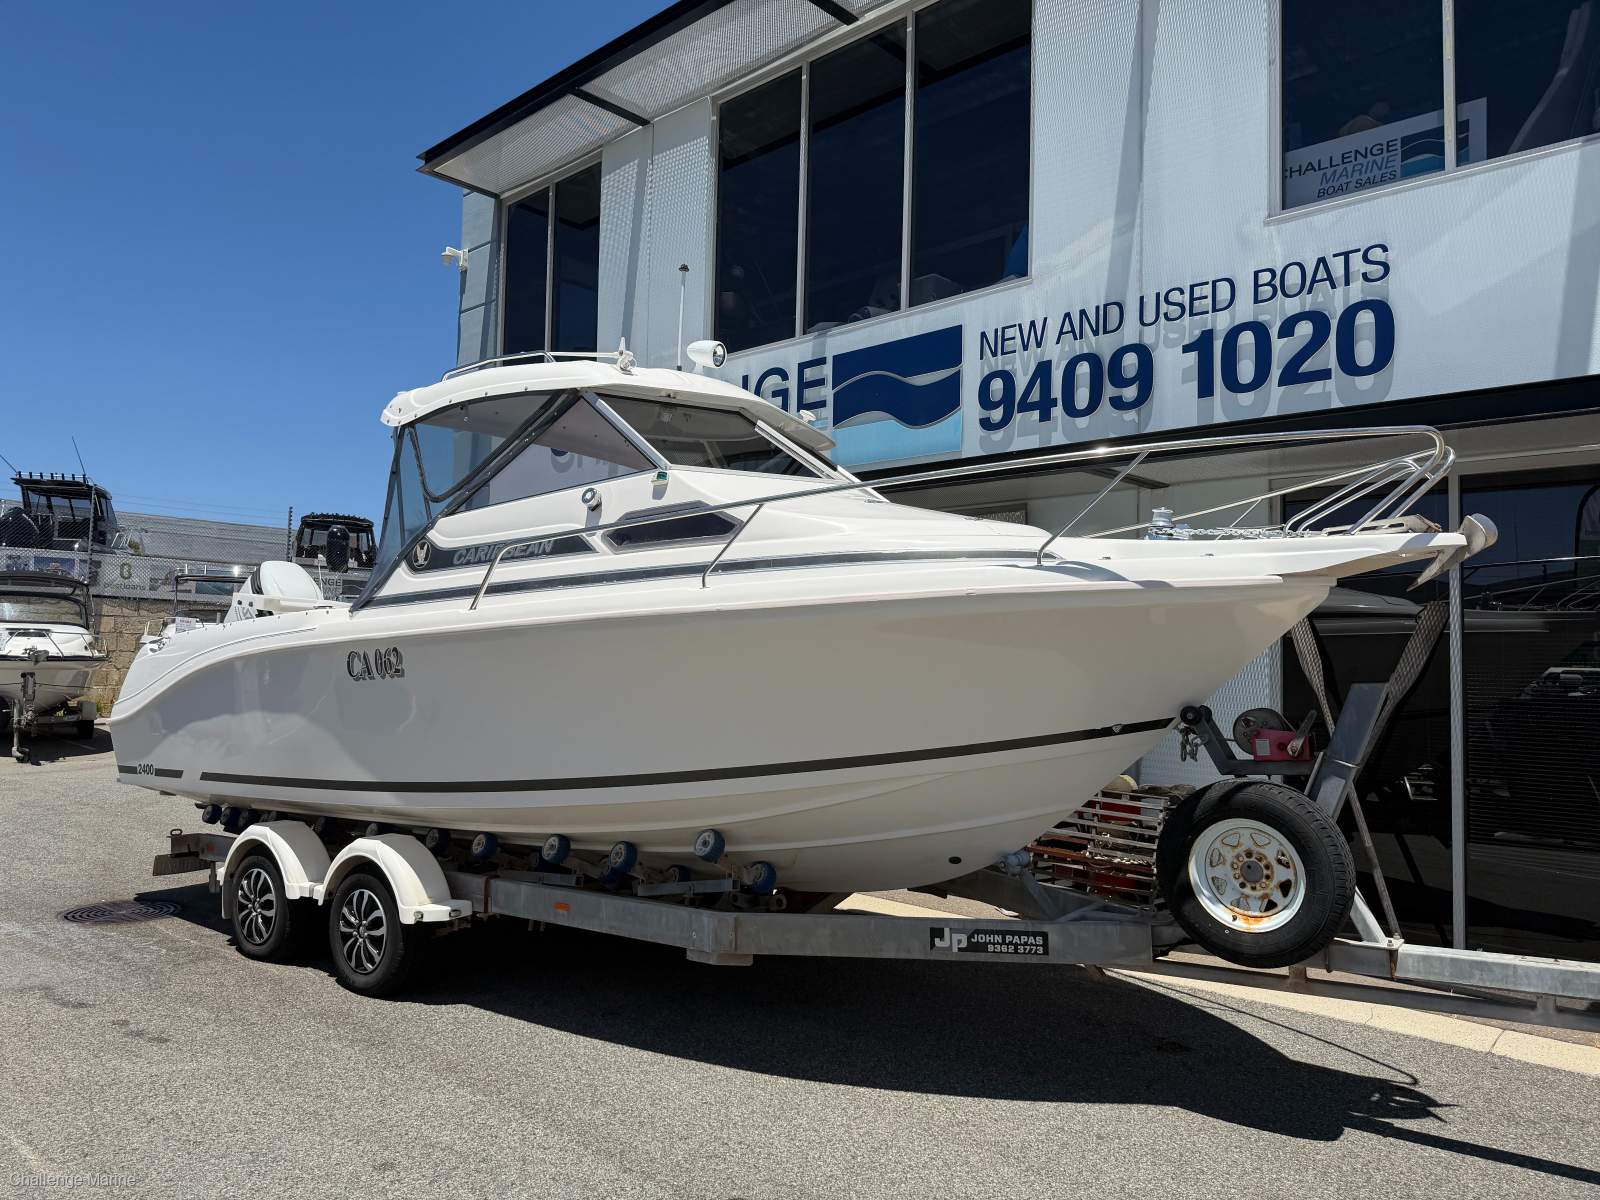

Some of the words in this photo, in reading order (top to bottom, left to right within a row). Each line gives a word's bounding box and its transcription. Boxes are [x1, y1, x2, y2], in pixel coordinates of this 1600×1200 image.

[1317, 181, 1351, 199] BOAT
[1354, 170, 1397, 189] SALES
[1320, 153, 1399, 186] MARINE
[979, 317, 1048, 361] NEW
[1055, 301, 1125, 345] AND
[1138, 277, 1236, 328] USED
[1252, 243, 1391, 305] BOATS
[978, 343, 1154, 432] 9409
[1181, 299, 1395, 399] 1020
[741, 356, 827, 413] GE
[347, 649, 375, 681] CA
[374, 647, 405, 679] 062
[137, 763, 154, 776] 2400
[971, 934, 1002, 943] JOHN
[1005, 935, 1044, 945] PAPAS
[1017, 945, 1044, 954] 3773
